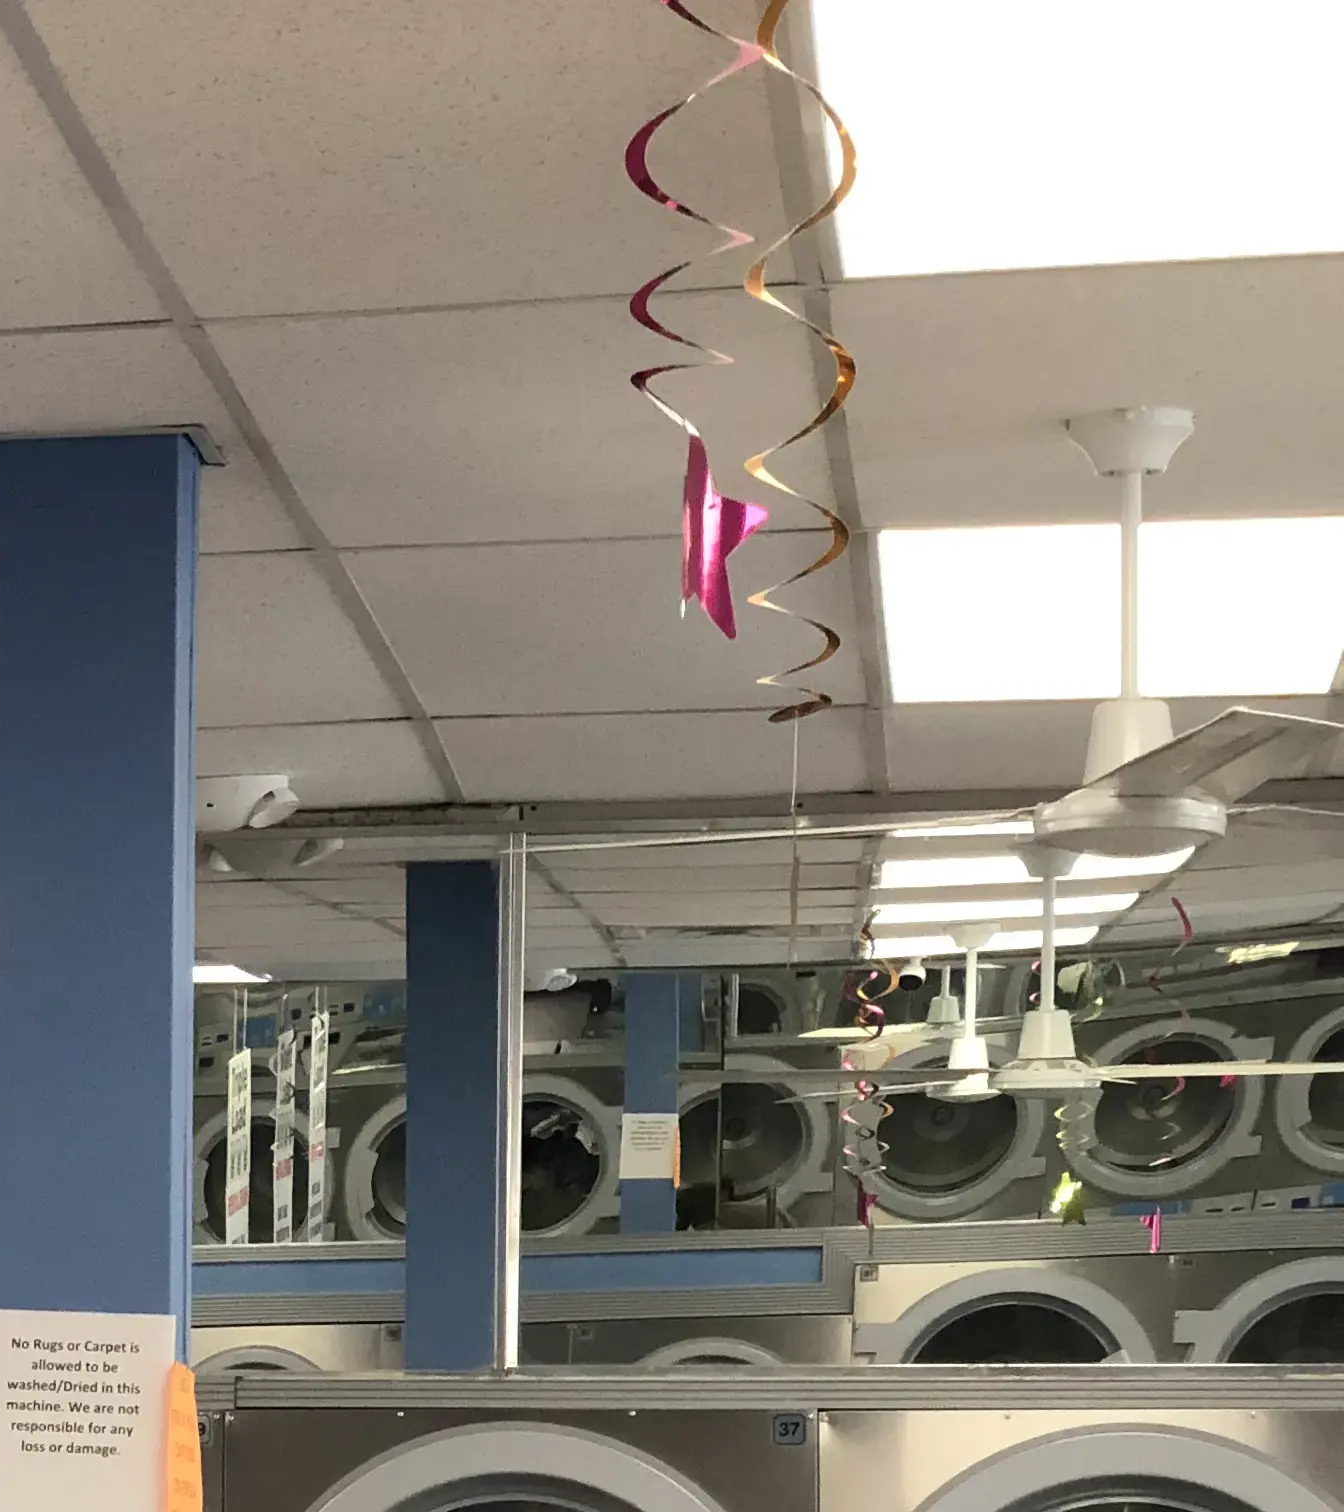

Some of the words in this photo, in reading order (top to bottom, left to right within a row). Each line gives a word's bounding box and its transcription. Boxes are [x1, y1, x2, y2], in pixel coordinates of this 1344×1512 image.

[11, 1338, 29, 1349] No
[33, 1339, 63, 1353] Rugs
[67, 1342, 81, 1351] or
[84, 1341, 126, 1354] Carpet
[130, 1342, 140, 1353] is
[31, 1359, 81, 1371] allowed
[86, 1362, 98, 1372] to
[103, 1361, 118, 1373] be
[8, 1379, 98, 1393] washed/Dried
[102, 1382, 113, 1393] in
[117, 1382, 140, 1394] this
[7, 1400, 64, 1412] machine.
[68, 1402, 90, 1413] We
[93, 1404, 114, 1414] are
[118, 1405, 140, 1415] not
[11, 1421, 84, 1433] responsible
[88, 1422, 107, 1434] for
[110, 1426, 133, 1437] any
[779, 1422, 800, 1437] 37
[21, 1440, 45, 1451] loss
[49, 1443, 63, 1452] or
[66, 1442, 120, 1457] damage.
